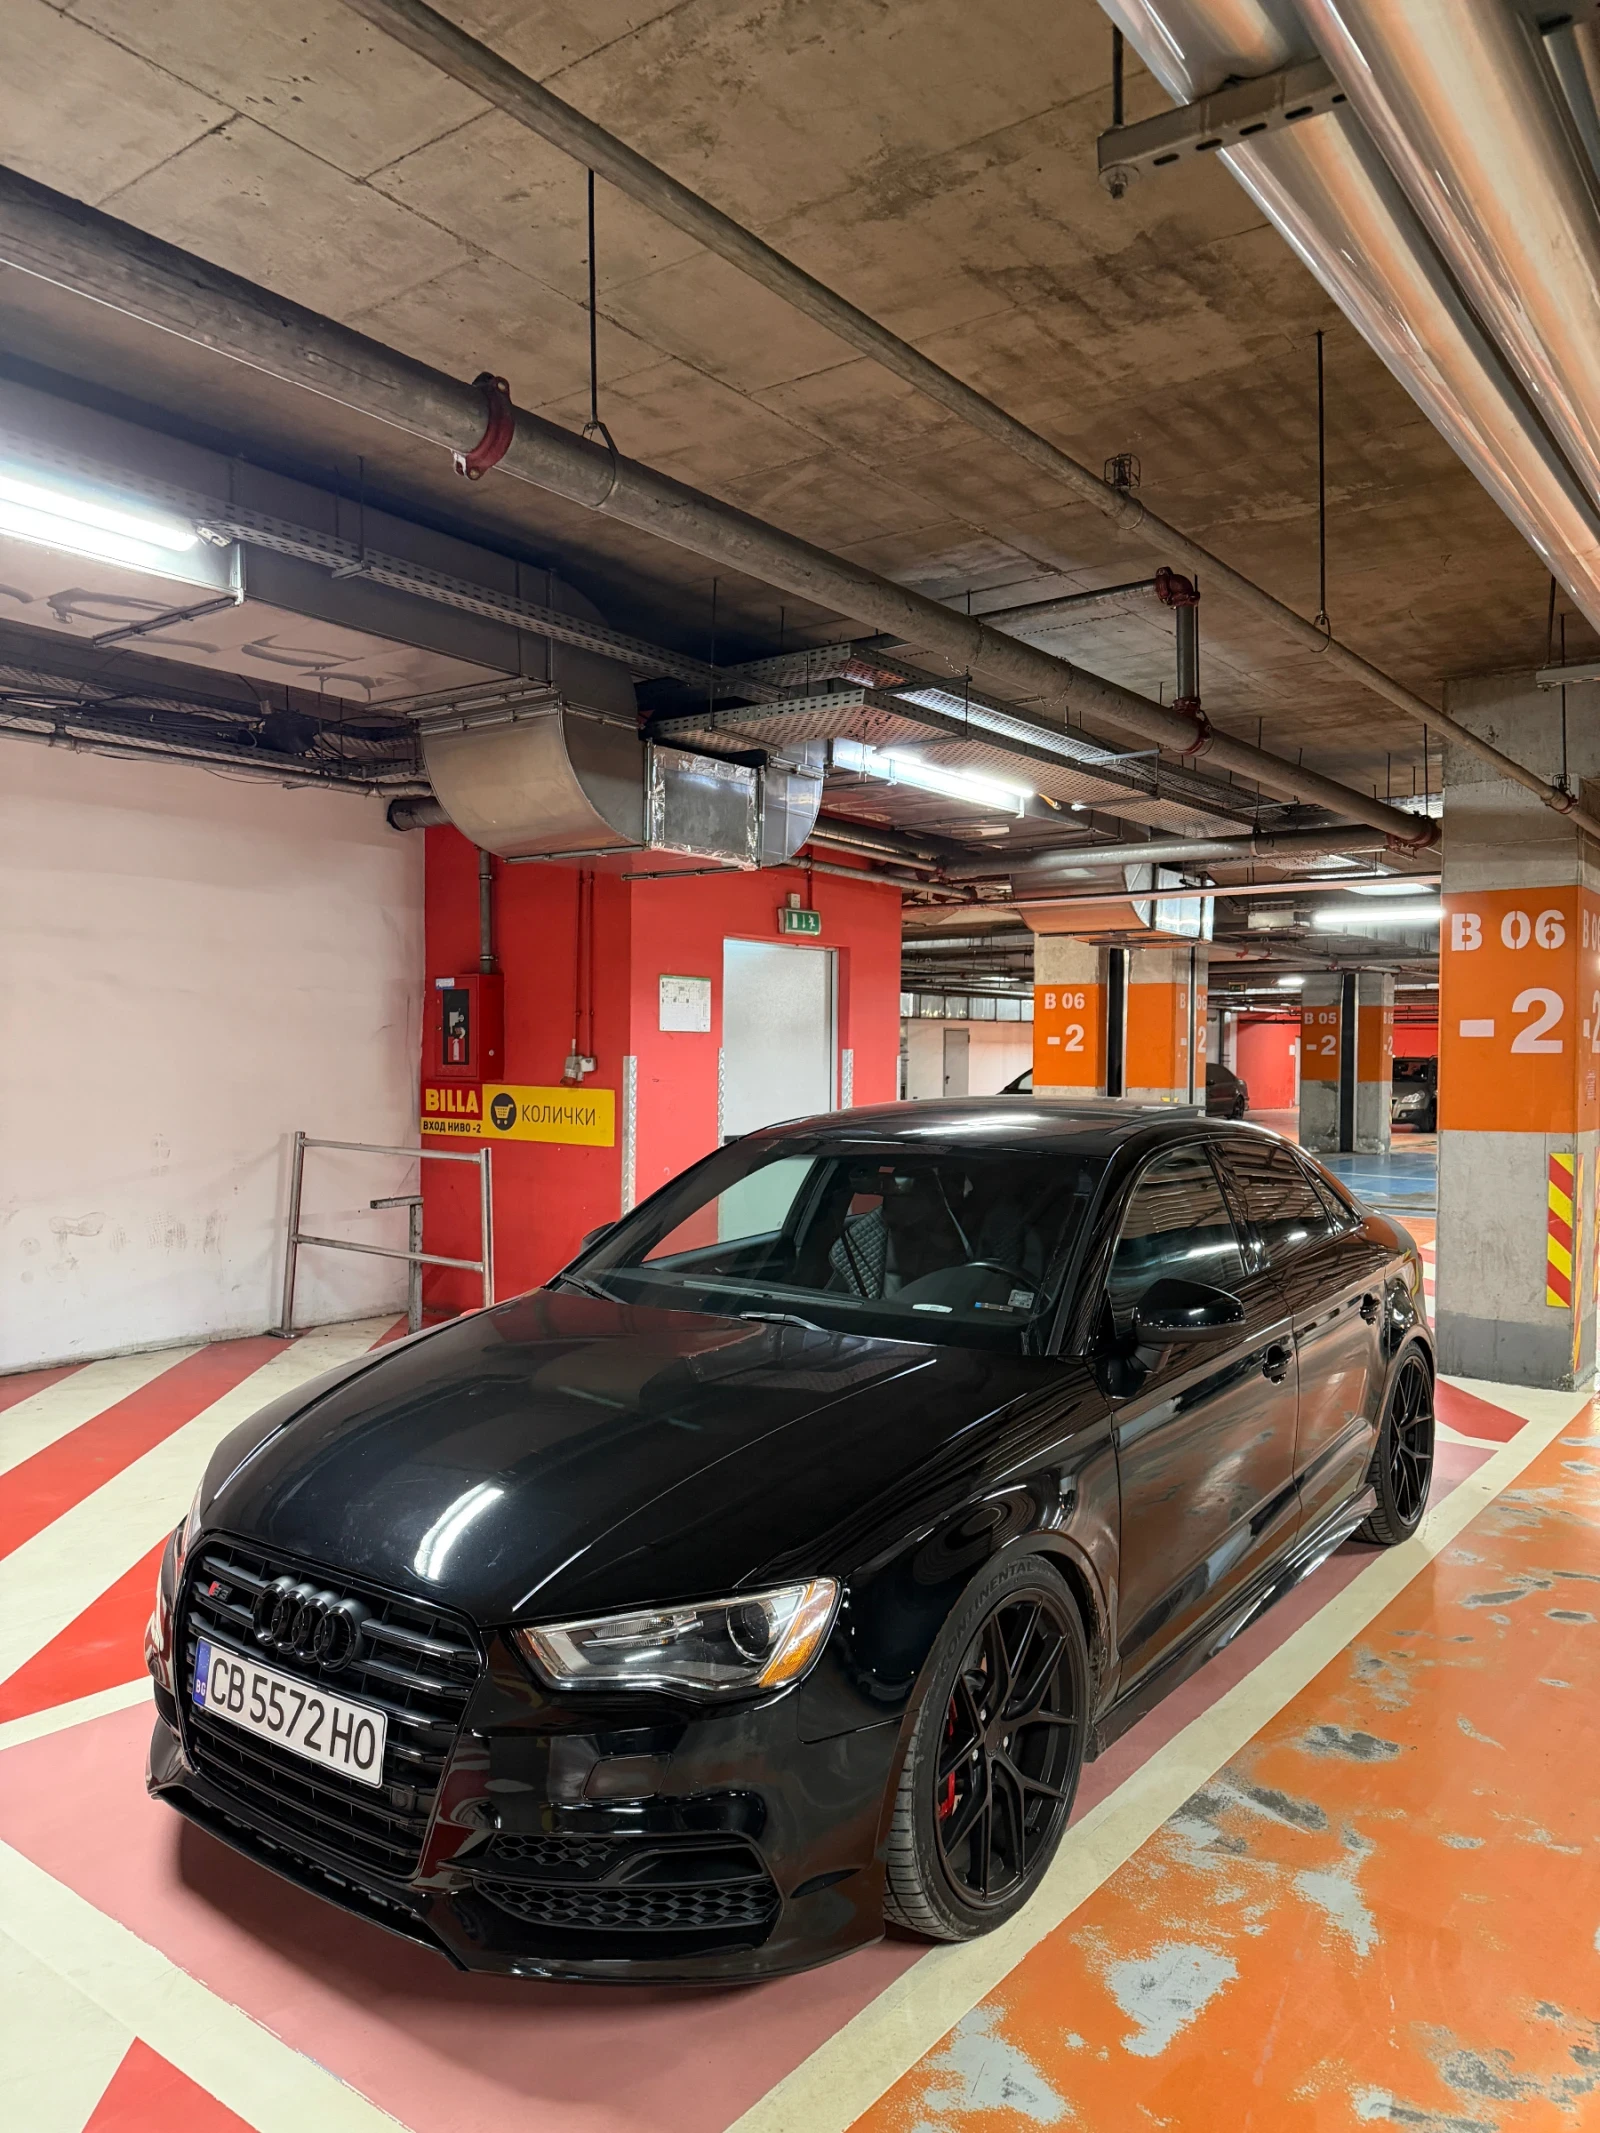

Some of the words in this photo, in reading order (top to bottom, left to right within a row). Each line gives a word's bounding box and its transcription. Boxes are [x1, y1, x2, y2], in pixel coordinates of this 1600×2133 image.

[1452, 913, 1483, 951] B
[1501, 909, 1566, 950] 06
[1044, 993, 1057, 1010] B
[1061, 992, 1085, 1010] 06
[1304, 1012, 1314, 1025] B
[1318, 1012, 1337, 1025] 05
[425, 1088, 479, 1113] BILLA
[521, 1104, 596, 1126] КОЛИЧКИ
[423, 1121, 446, 1133] ВХОД
[447, 1122, 471, 1133] НИВО
[472, 1124, 481, 1134] -2
[195, 1679, 207, 1697] BG
